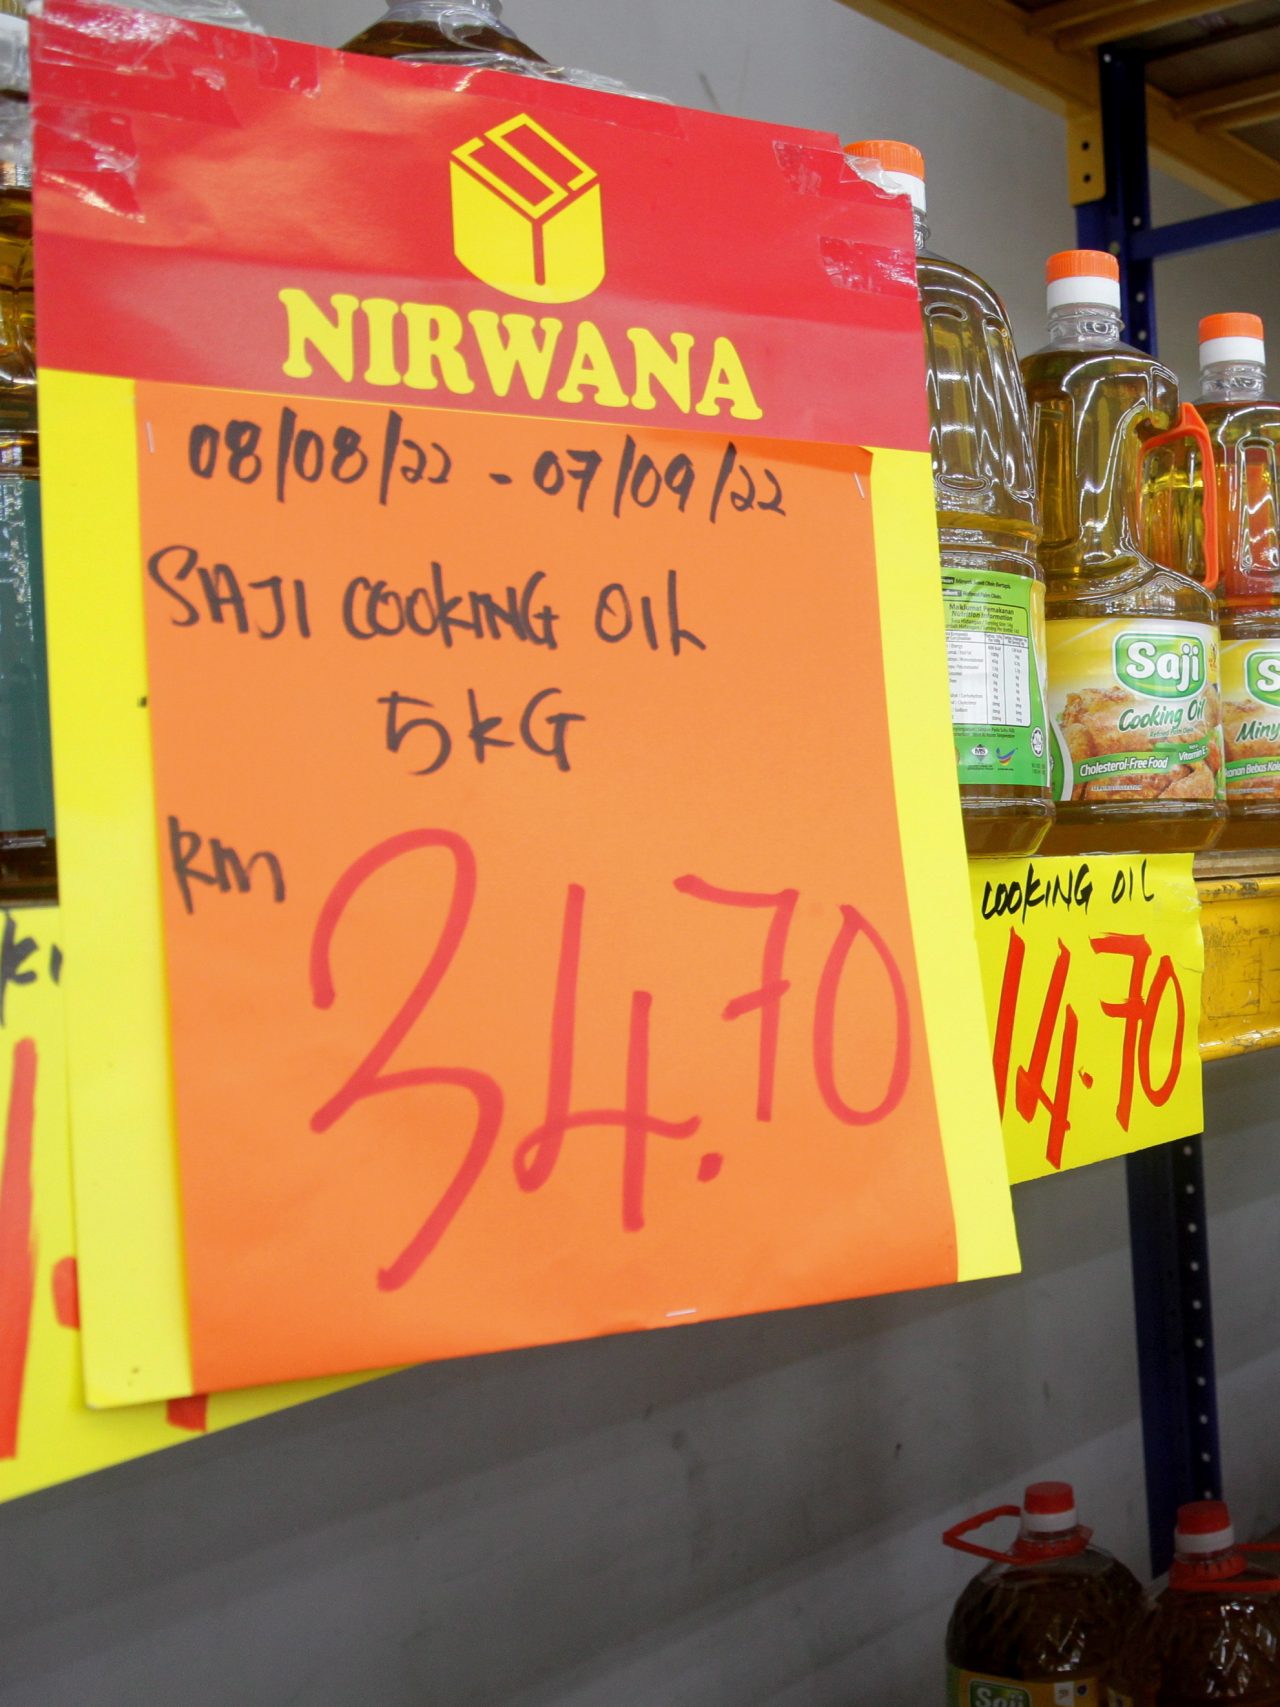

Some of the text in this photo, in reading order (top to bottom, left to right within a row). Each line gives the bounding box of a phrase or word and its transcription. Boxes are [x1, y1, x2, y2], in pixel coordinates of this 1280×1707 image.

[278, 288, 763, 422] NIRWANA
[188, 406, 453, 506] 08/08/22
[532, 434, 787, 525] 07/09/22
[147, 545, 707, 657] SAJI COOKING OIL
[1125, 641, 1200, 692] Saji
[1118, 699, 1206, 732] Cooking Oil
[1079, 756, 1168, 777] Cholesterol-Free Food
[1178, 749, 1202, 761] Vitamin
[1246, 762, 1267, 774] Bebas
[981, 858, 1155, 925] COOKING OIL
[308, 827, 912, 1292] 34.70
[992, 925, 1186, 1170] 14.70
